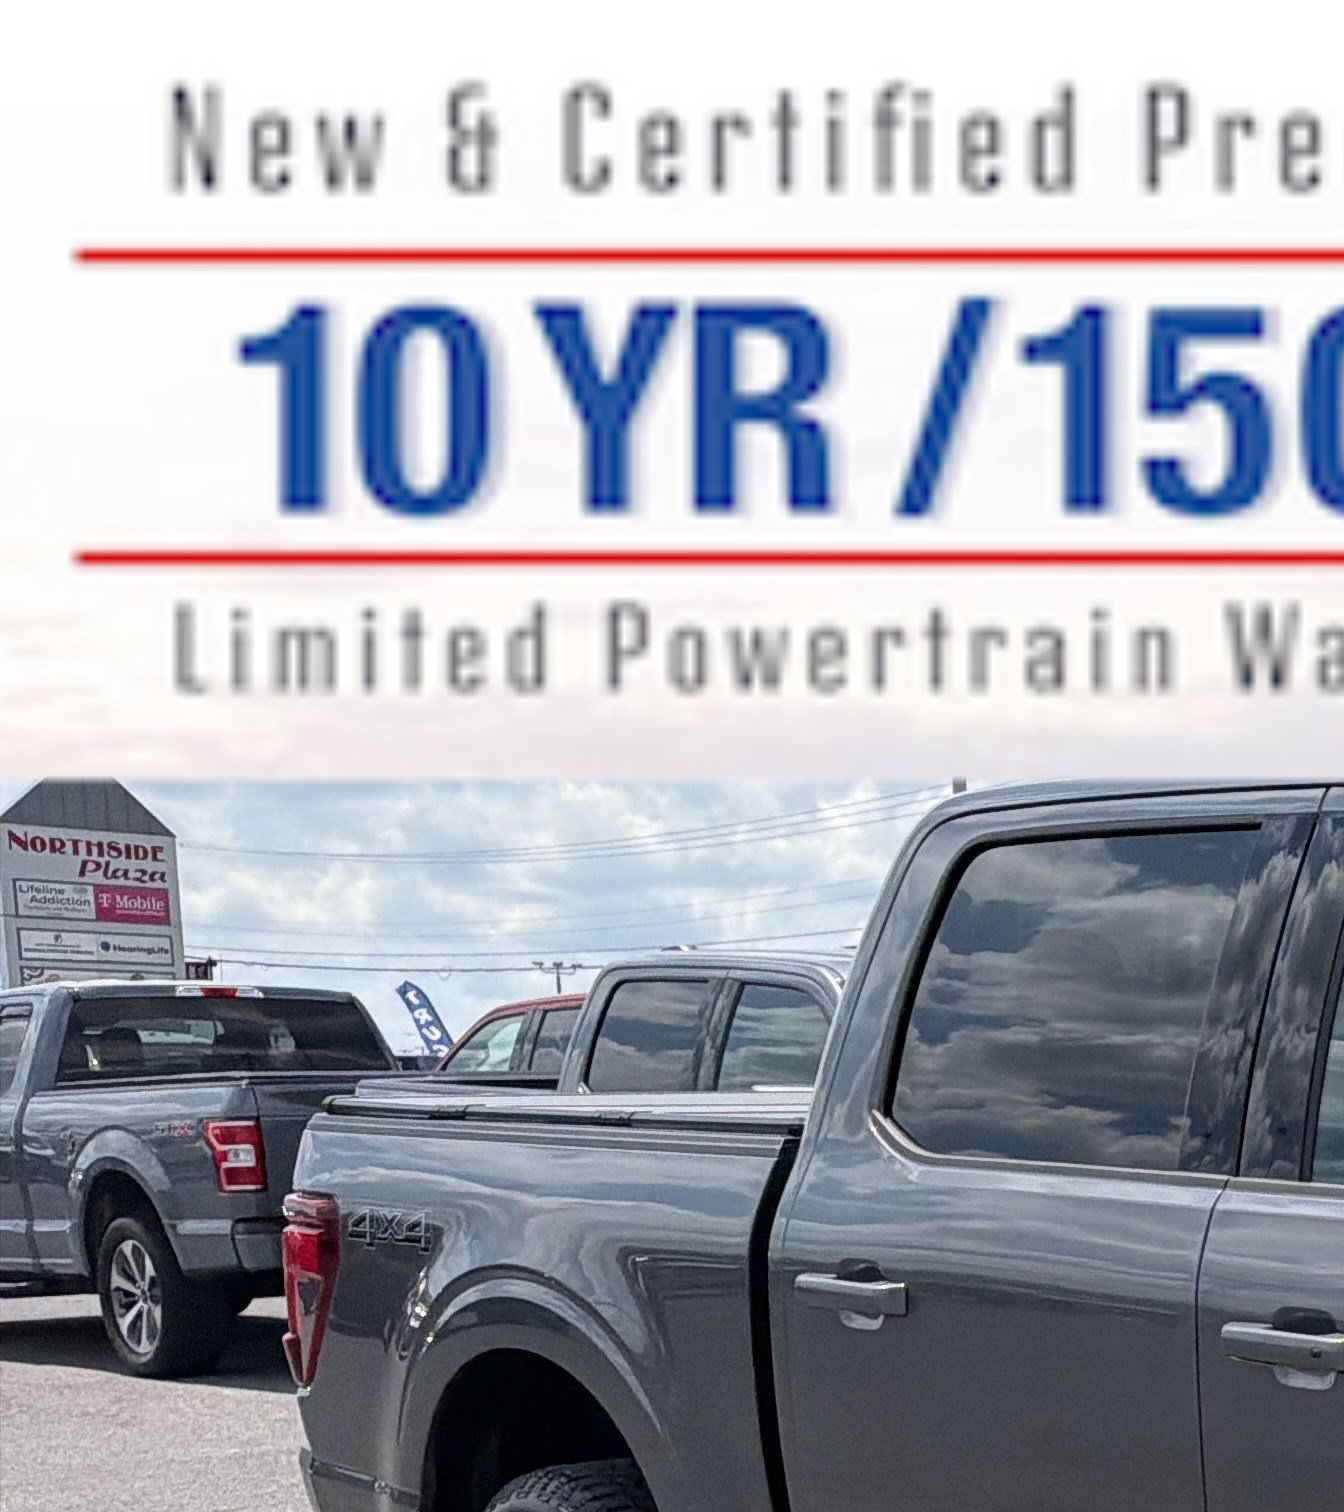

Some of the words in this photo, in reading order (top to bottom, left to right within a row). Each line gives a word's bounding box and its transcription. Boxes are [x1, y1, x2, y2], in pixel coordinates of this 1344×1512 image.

[7, 829, 165, 863] NORTHSIDE
[78, 859, 167, 883] Plaza
[18, 884, 66, 895] Lifeline
[29, 895, 91, 907] Addiction
